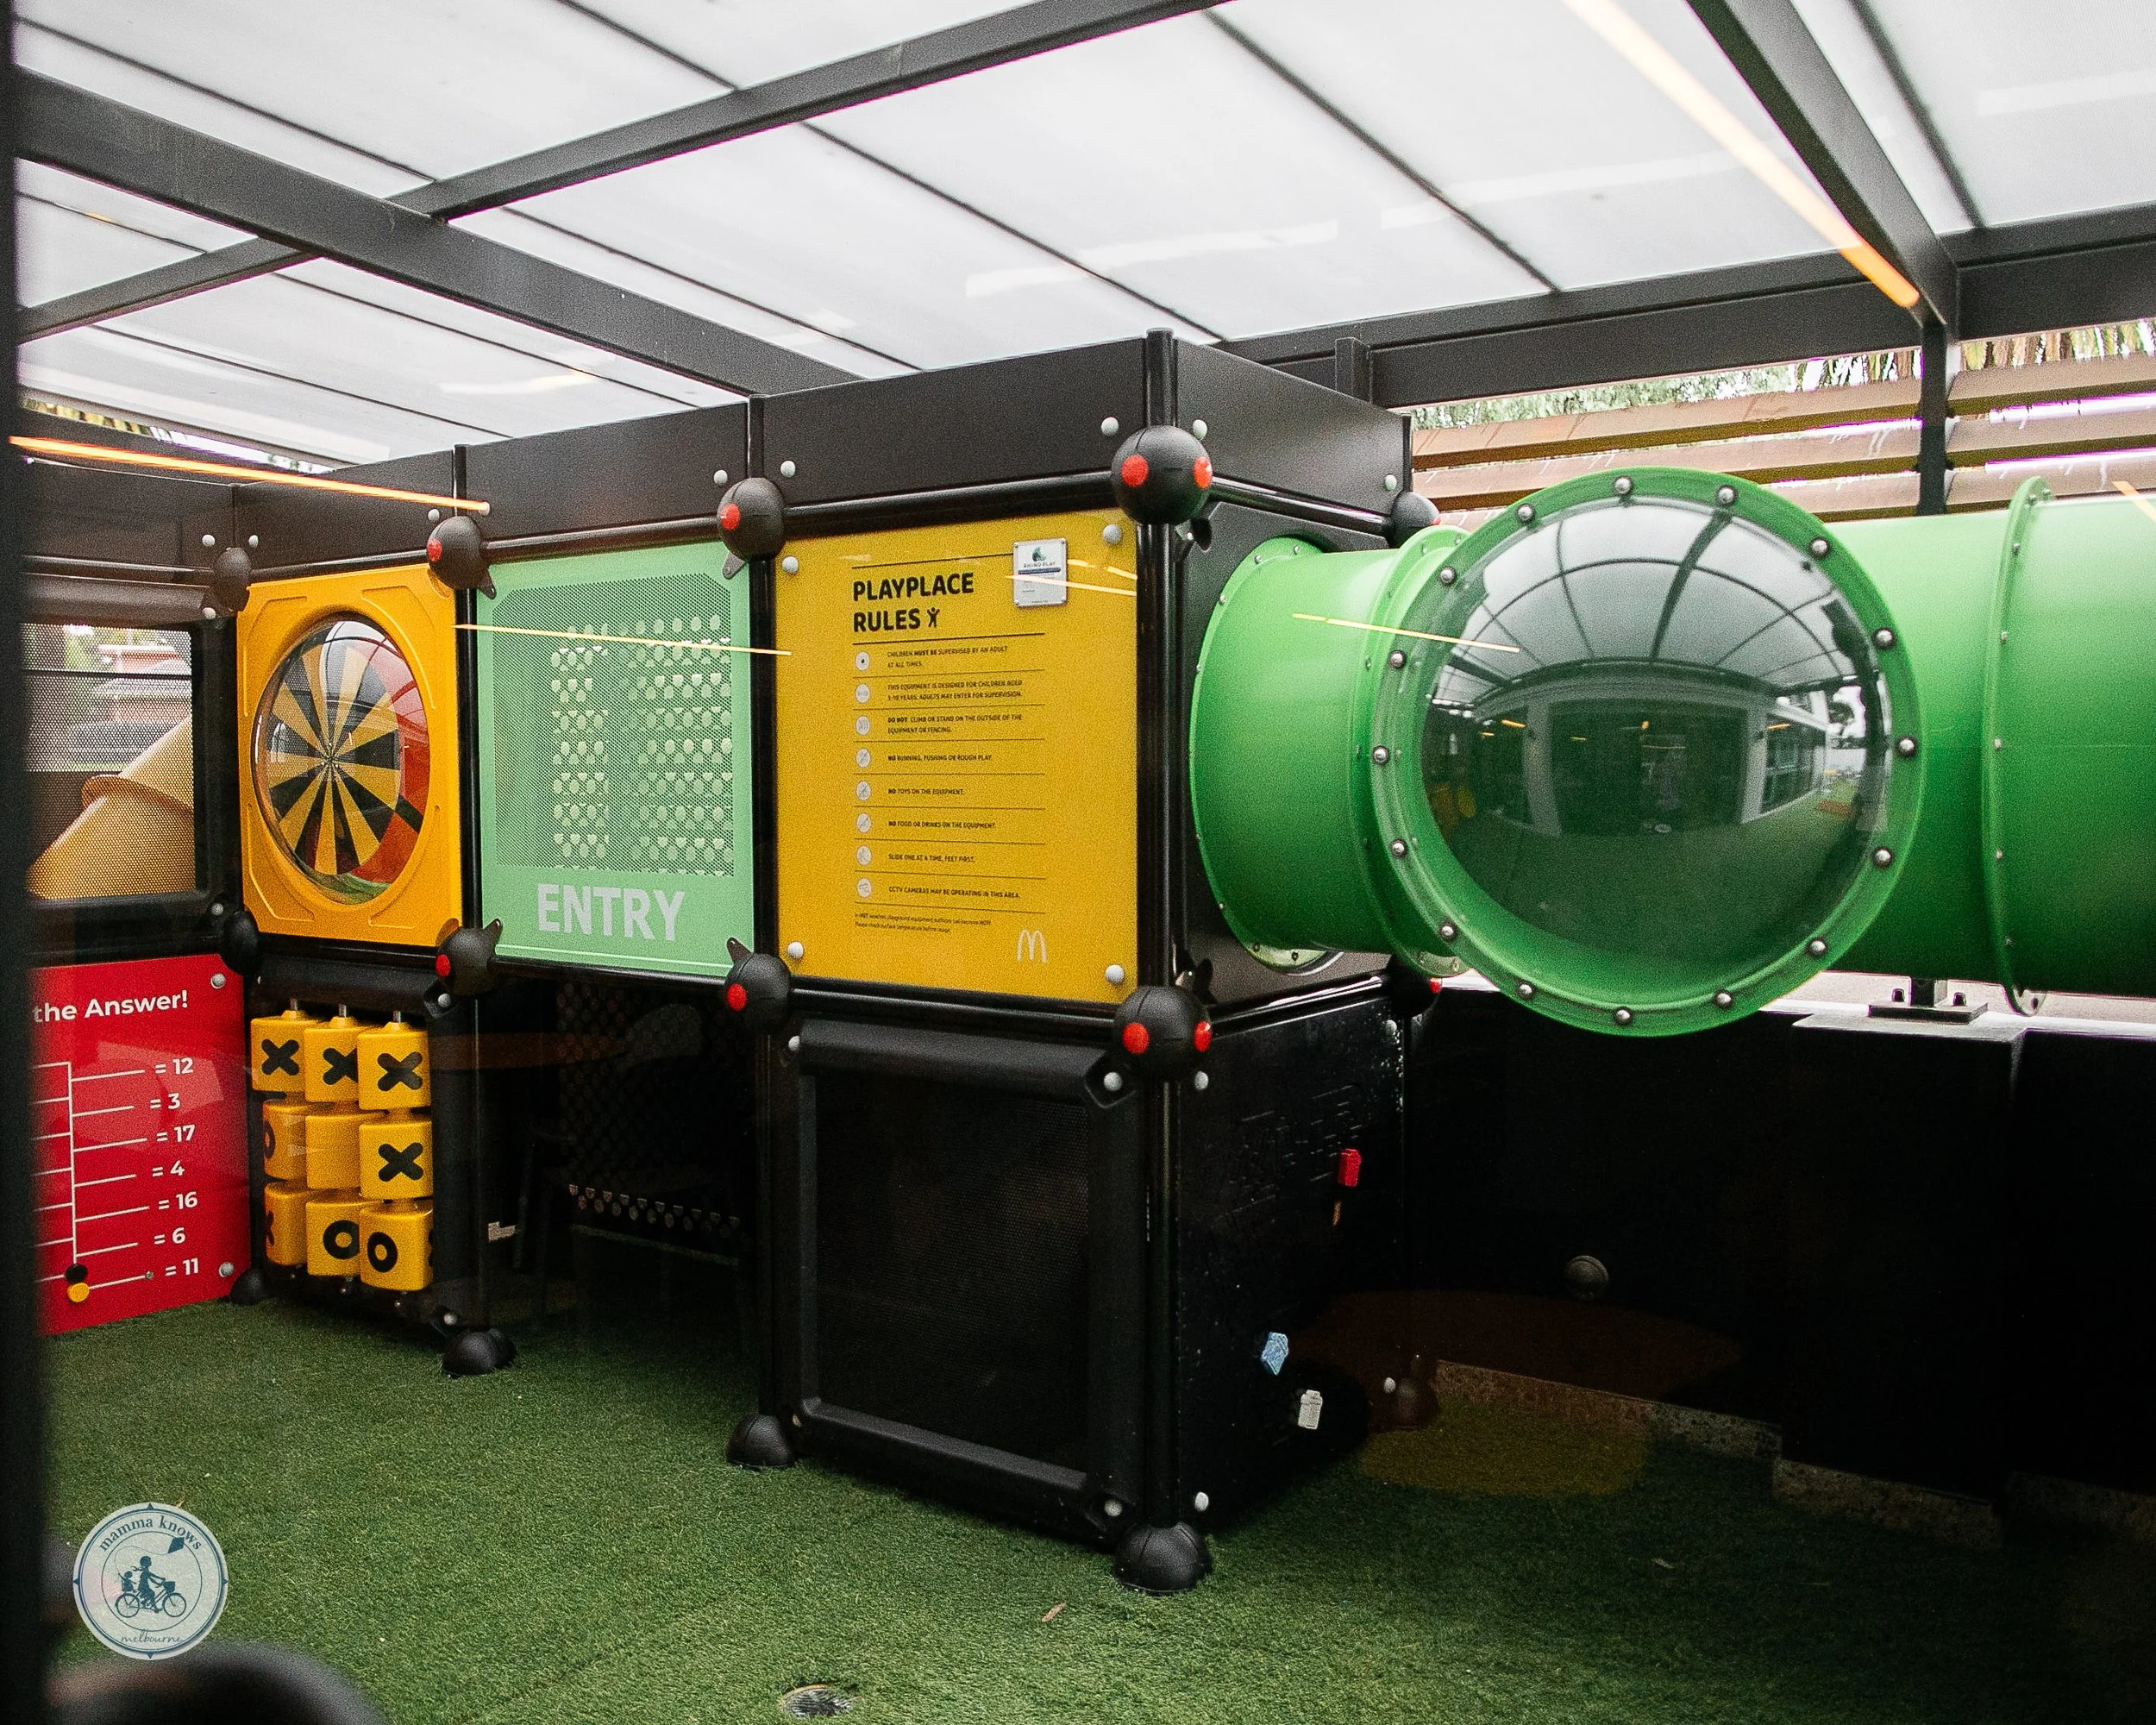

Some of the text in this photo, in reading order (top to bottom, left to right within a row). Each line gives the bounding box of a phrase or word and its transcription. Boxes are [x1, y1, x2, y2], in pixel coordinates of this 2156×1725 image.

[853, 572, 974, 601] PLAYPLACE
[853, 608, 921, 632] RULES
[537, 883, 686, 941] ENTRY
[85, 989, 188, 1018] Answer!
[172, 1057, 194, 1075] 12
[167, 1093, 181, 1110] 3
[174, 1124, 196, 1143] 17
[170, 1161, 185, 1176] 4
[176, 1192, 198, 1210] 16
[172, 1227, 186, 1245] 6
[183, 1258, 199, 1275] 11
